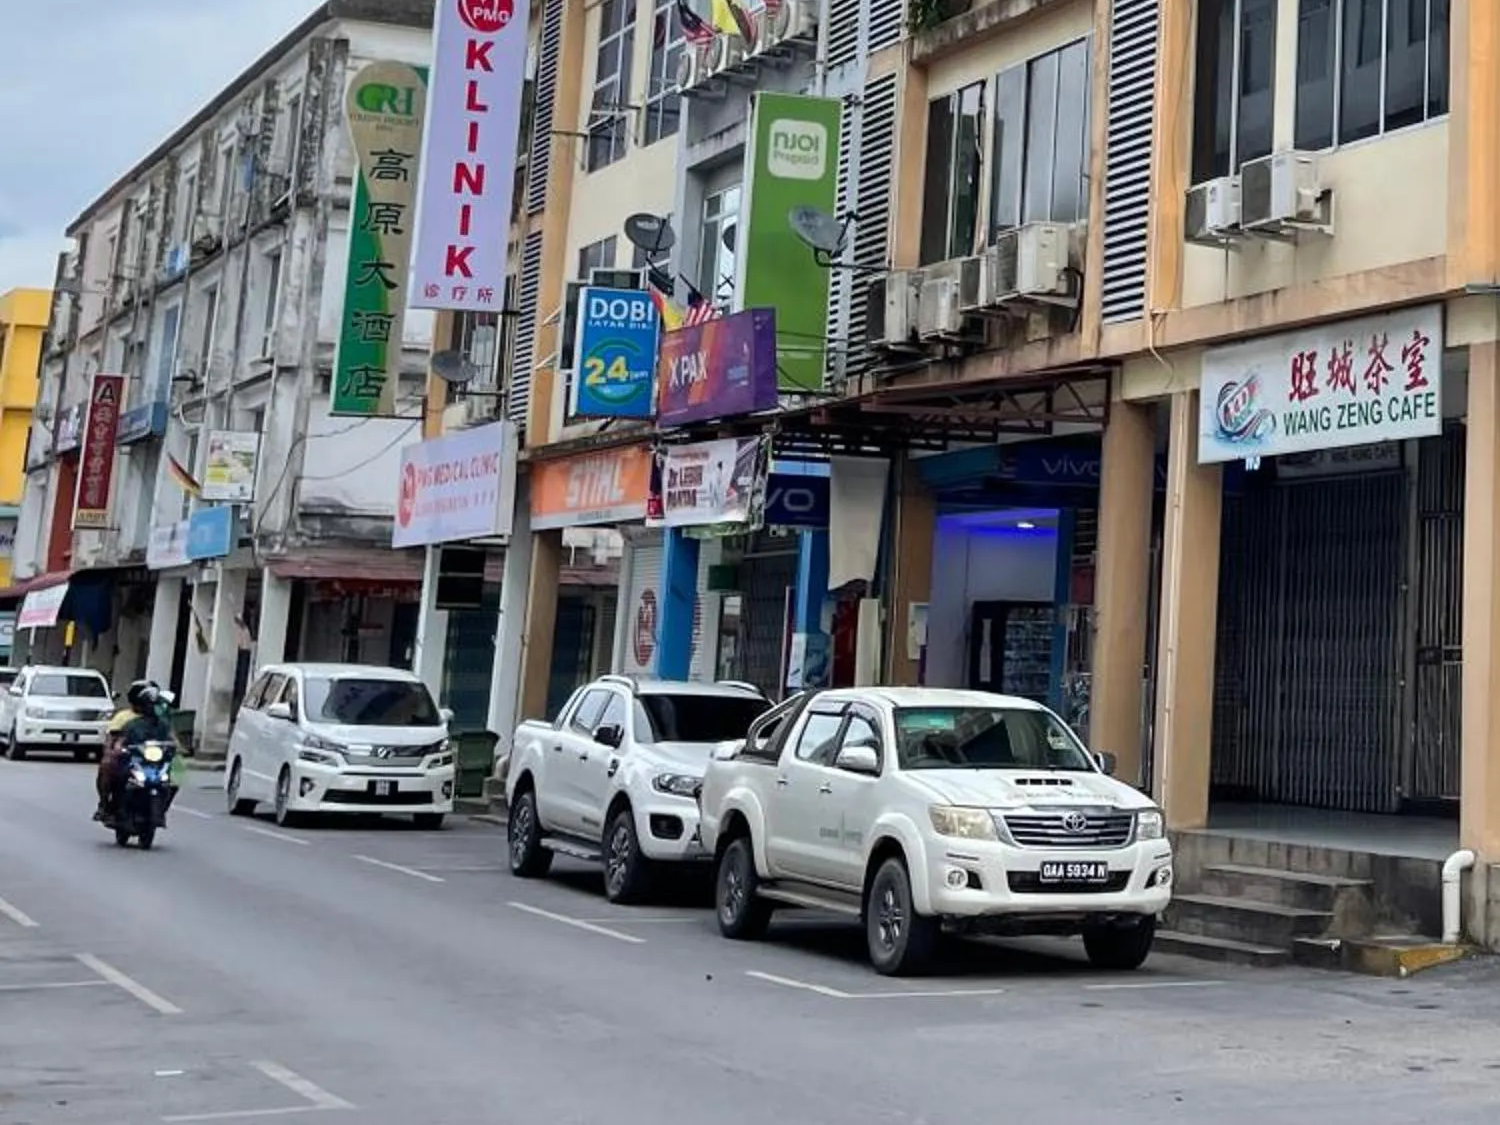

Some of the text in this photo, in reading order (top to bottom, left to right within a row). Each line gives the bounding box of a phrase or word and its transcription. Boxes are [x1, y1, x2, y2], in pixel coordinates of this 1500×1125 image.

[445, 38, 495, 278] KLINIK
[341, 148, 414, 399] 高原大酒店
[590, 296, 654, 322] DOBI
[584, 355, 629, 386] 24
[1288, 330, 1431, 402] 旺城茶室
[1283, 391, 1436, 436] WANG ZENG CAFE
[433, 459, 470, 485] MEDICAL
[470, 452, 499, 478] CLINIC
[1097, 864, 1106, 878] N
